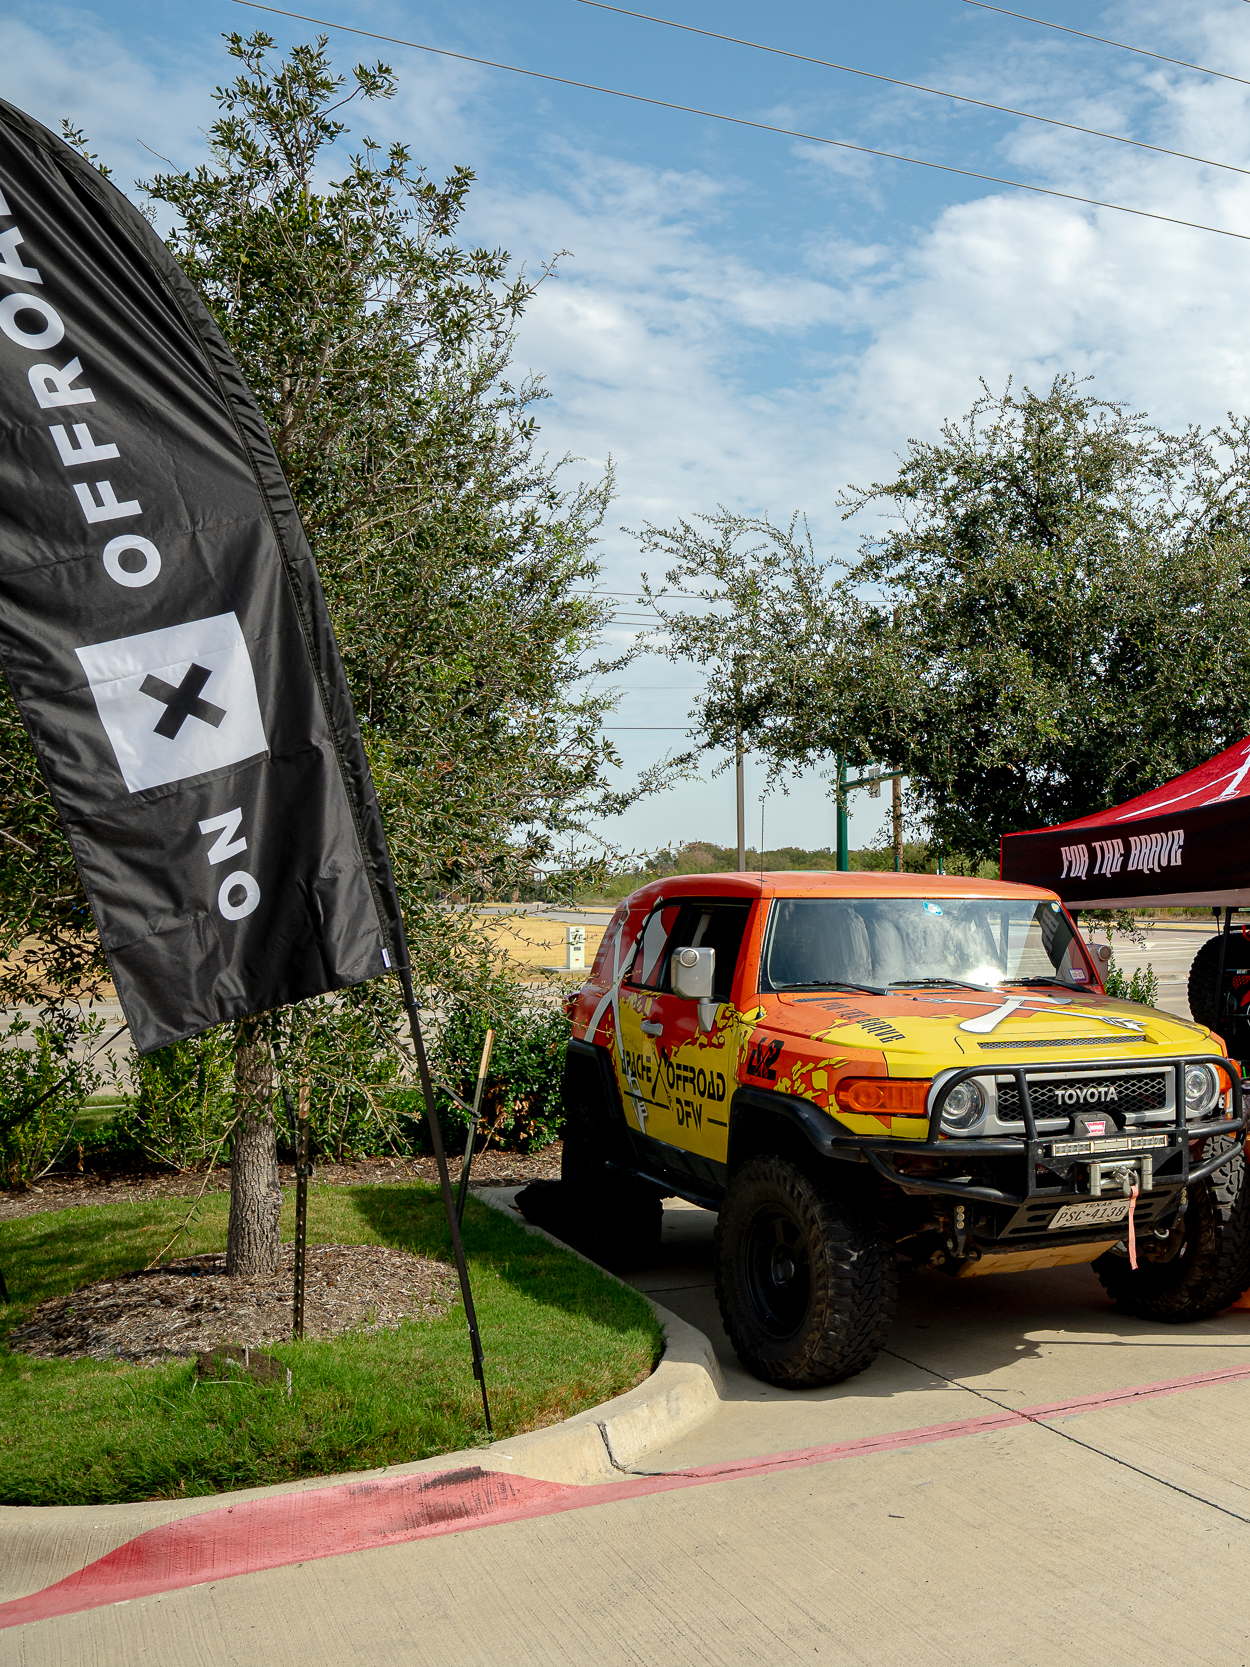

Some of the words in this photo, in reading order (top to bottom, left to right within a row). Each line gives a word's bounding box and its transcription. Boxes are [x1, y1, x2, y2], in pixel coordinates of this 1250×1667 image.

[0, 186, 162, 588] OFFROA
[199, 807, 261, 921] ON
[1060, 844, 1089, 880] FOR
[1091, 838, 1125, 878] THE
[1126, 828, 1185, 874] BRAVE
[856, 1017, 906, 1044] BRAVE
[666, 1060, 726, 1103] OFFROAD
[1054, 1086, 1119, 1106] TOYOTA
[675, 1096, 703, 1132] DFW
[1084, 1201, 1113, 1209] TEXAS
